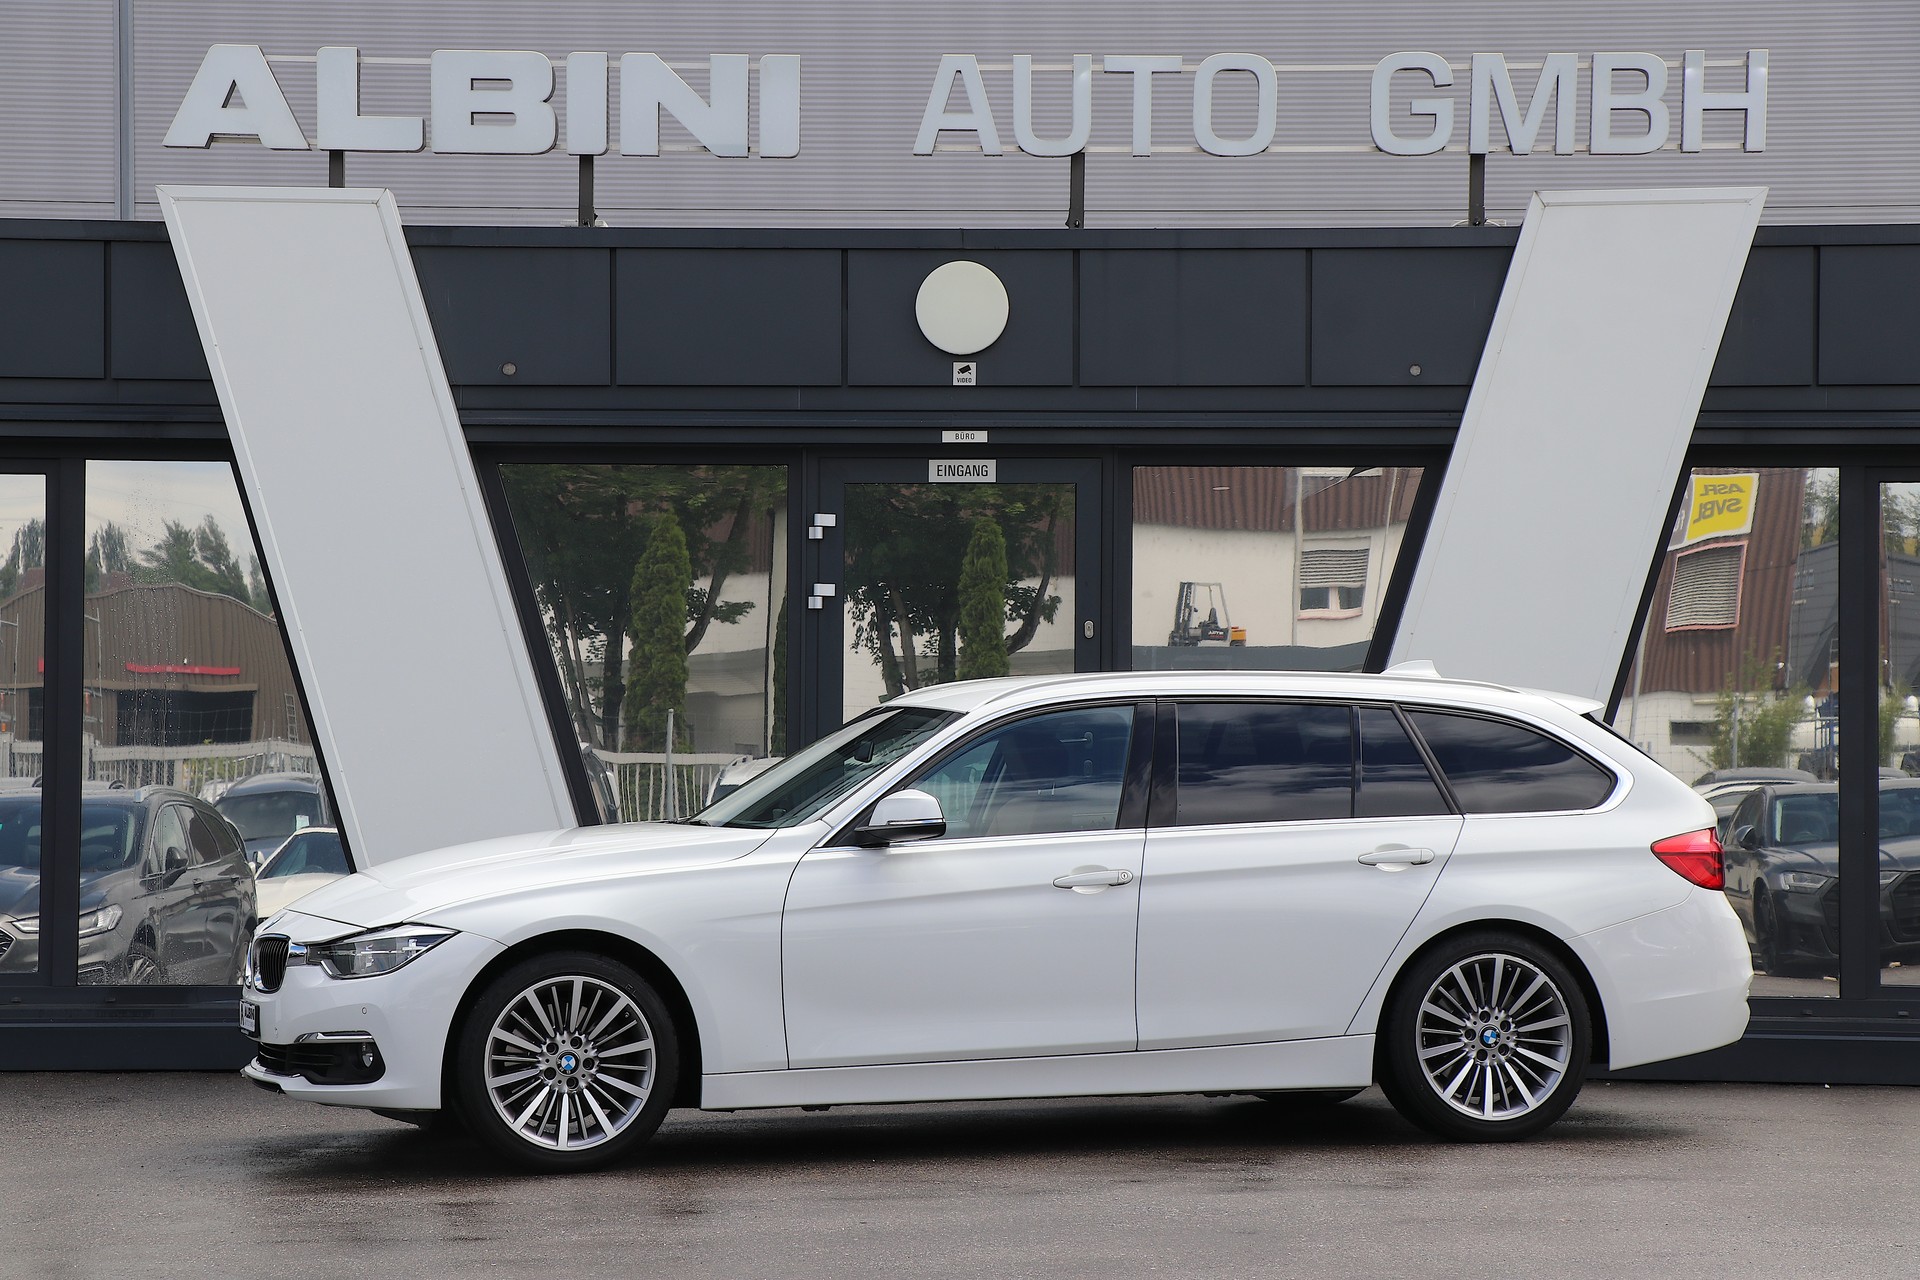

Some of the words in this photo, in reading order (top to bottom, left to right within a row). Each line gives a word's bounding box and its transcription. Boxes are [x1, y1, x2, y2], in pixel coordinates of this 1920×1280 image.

[162, 43, 801, 159] ALBINI
[912, 53, 1278, 157] AUTO
[1369, 49, 1769, 156] GMBH
[955, 432, 975, 440] BÜRO
[936, 464, 989, 477] EINGANG
